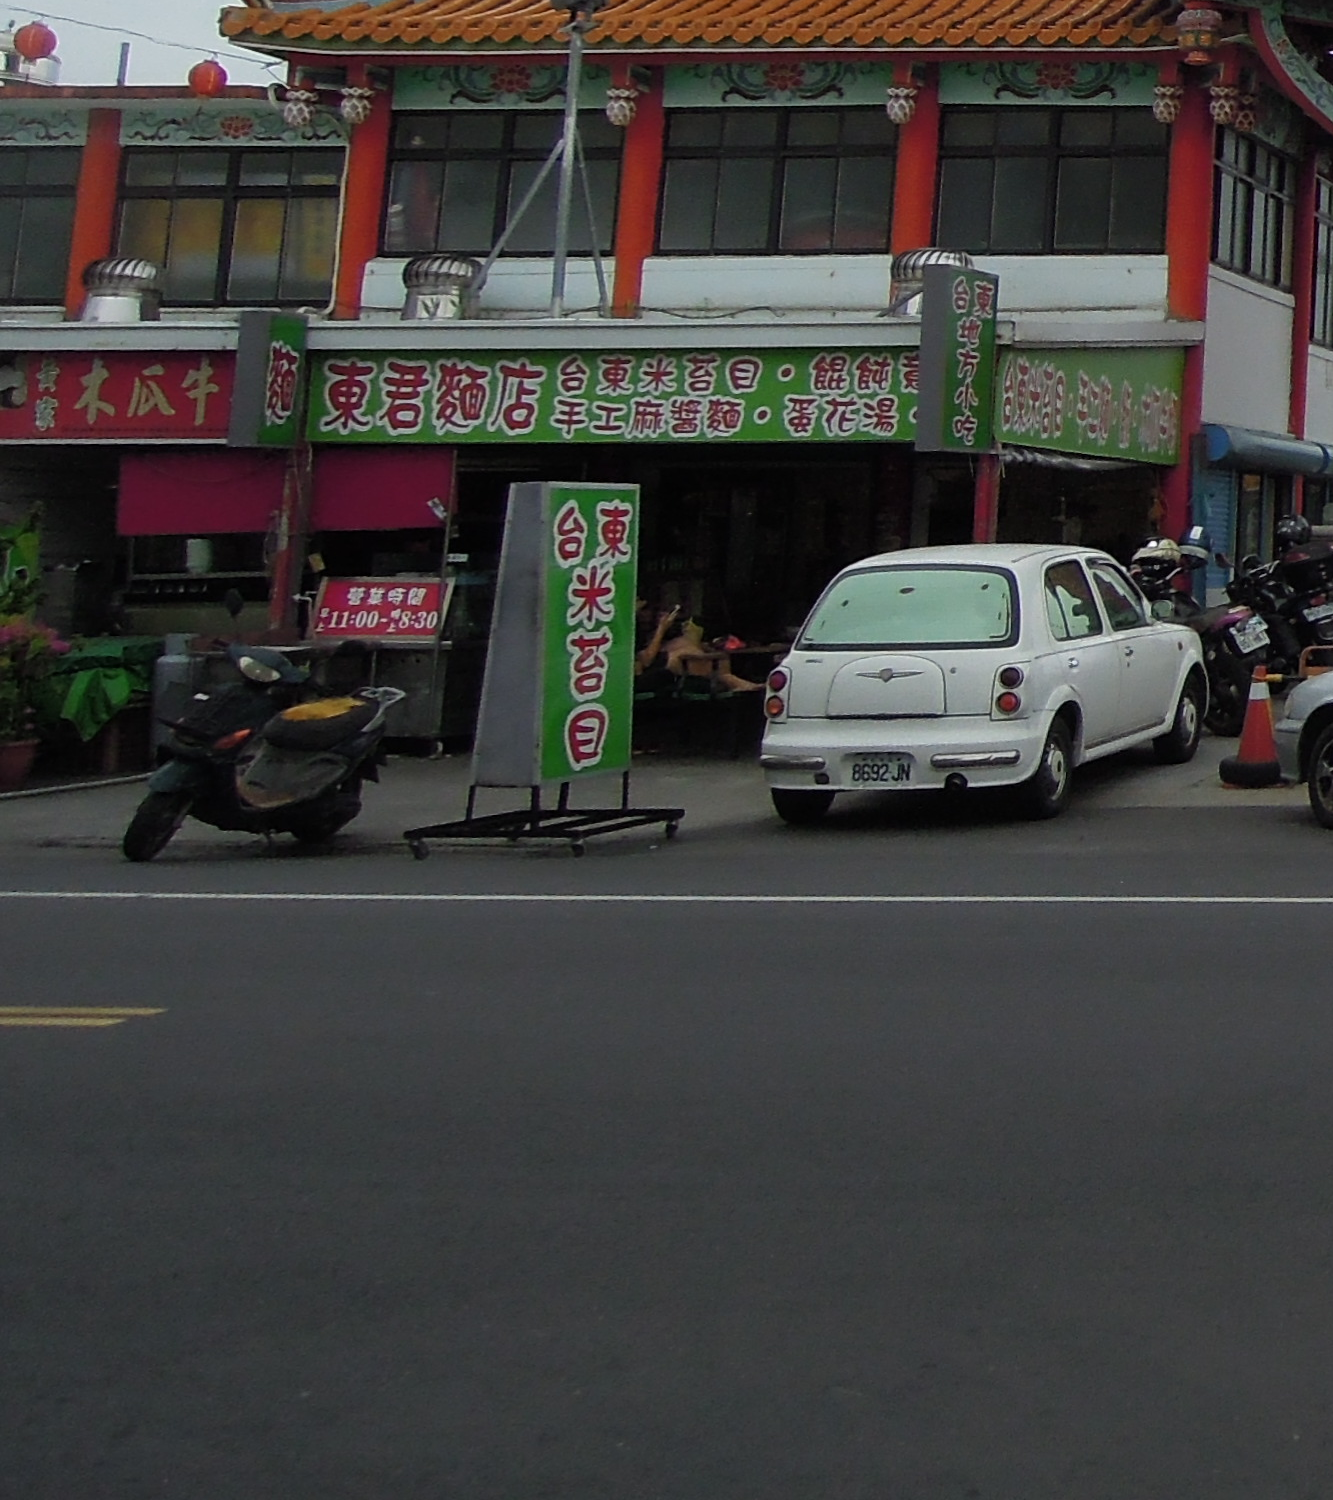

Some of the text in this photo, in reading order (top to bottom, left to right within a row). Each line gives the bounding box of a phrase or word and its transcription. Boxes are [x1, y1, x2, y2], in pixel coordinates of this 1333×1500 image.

[74, 356, 220, 426] 木瓜牛
[318, 357, 547, 436] 東君麵店
